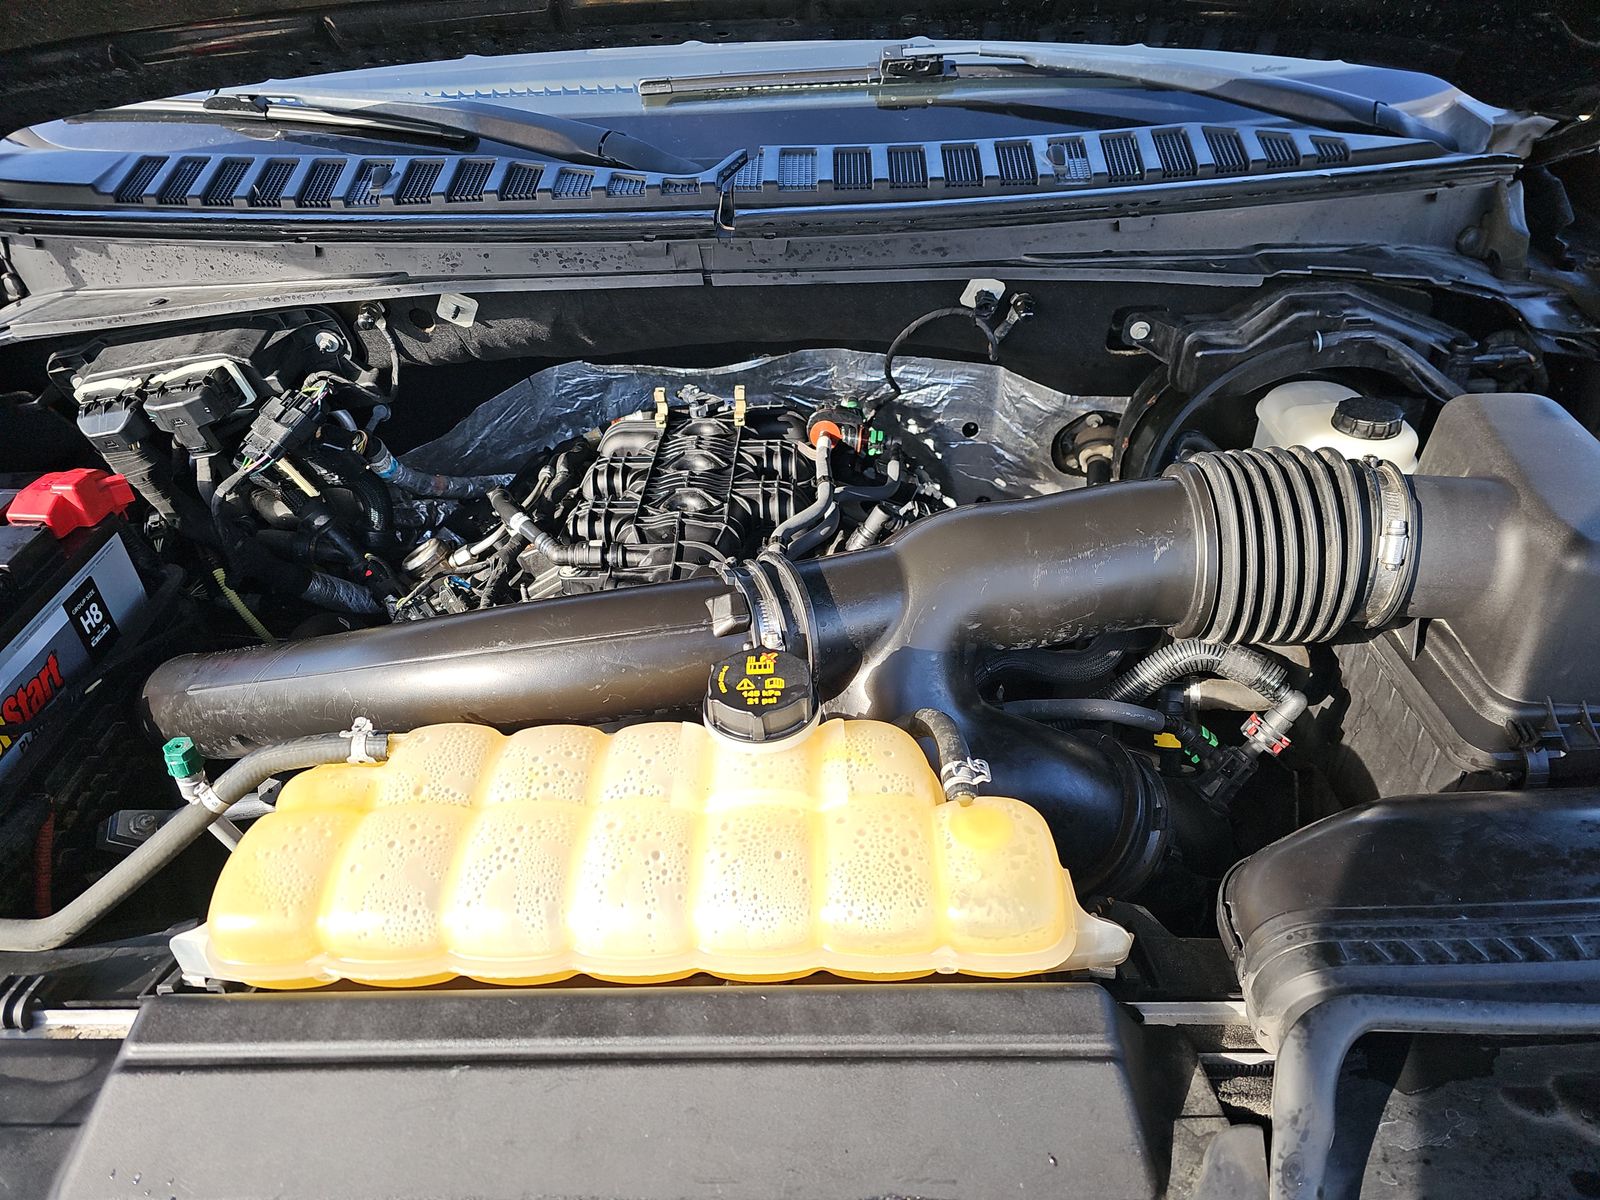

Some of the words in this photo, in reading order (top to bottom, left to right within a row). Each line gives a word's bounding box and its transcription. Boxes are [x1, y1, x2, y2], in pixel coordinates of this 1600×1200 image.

[71, 598, 87, 615] GROUP
[85, 588, 96, 601] SIZE
[79, 602, 103, 635] H8
[761, 696, 777, 705] psi
